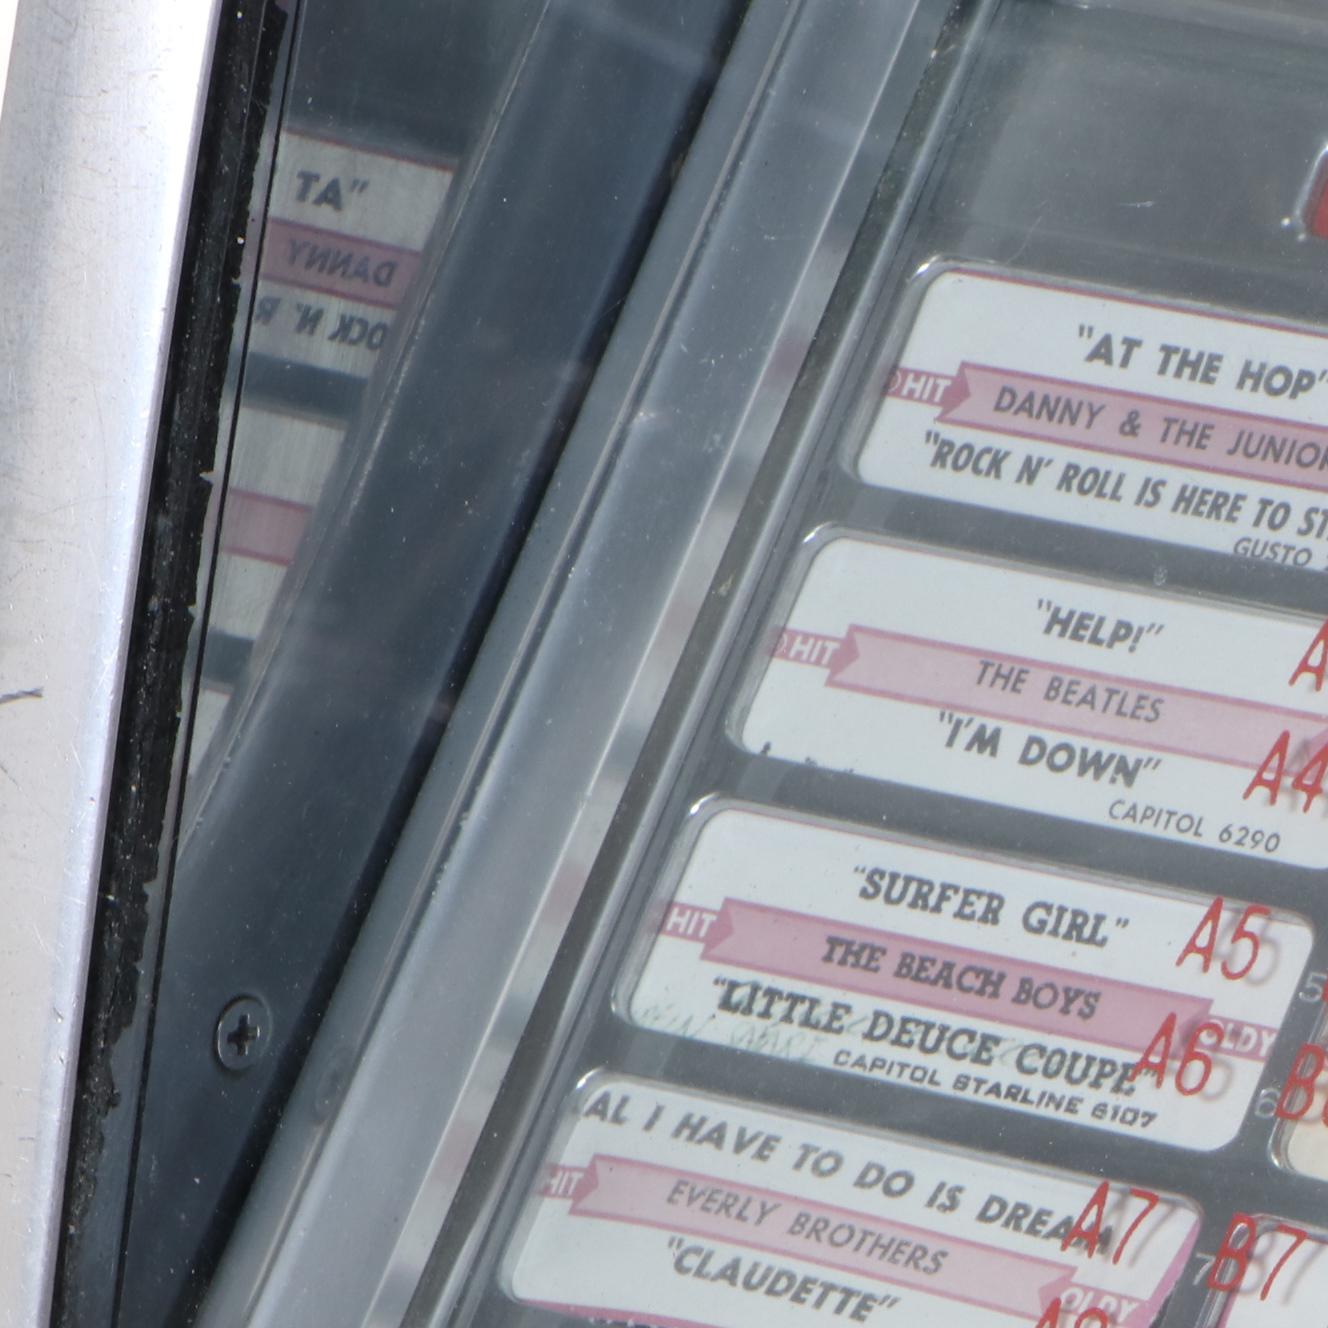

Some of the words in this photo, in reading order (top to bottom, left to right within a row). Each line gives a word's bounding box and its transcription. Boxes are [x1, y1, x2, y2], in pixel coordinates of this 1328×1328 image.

[1078, 324, 1142, 368] "AT
[1157, 343, 1223, 385] THE
[993, 385, 1105, 429] DANNY
[1118, 409, 1141, 437] &
[1160, 417, 1215, 450] THE
[1232, 539, 1312, 570] GUSTO
[1037, 599, 1164, 653] "HELP!"
[976, 660, 1030, 693] THE
[1043, 675, 1164, 723] BEATLES
[939, 711, 1001, 757] "I'M
[1018, 735, 1161, 788] DOWN"
[1108, 799, 1203, 837] CAPITOL
[1218, 824, 1280, 853] 6290
[854, 866, 1005, 925] "SURFER
[1022, 900, 1129, 947] GIRL"
[821, 935, 887, 973] THE
[893, 951, 1006, 999] BEACH
[1011, 976, 1101, 1020] BOYS
[833, 1049, 940, 1086] CAPITOL
[952, 1073, 1083, 1114] STARLINE
[1090, 1101, 1157, 1128] 6107
[666, 1178, 781, 1226] EVERLY
[787, 1211, 949, 1275] BROTHERS
[668, 1236, 899, 1322] "CLAUDETTE"
